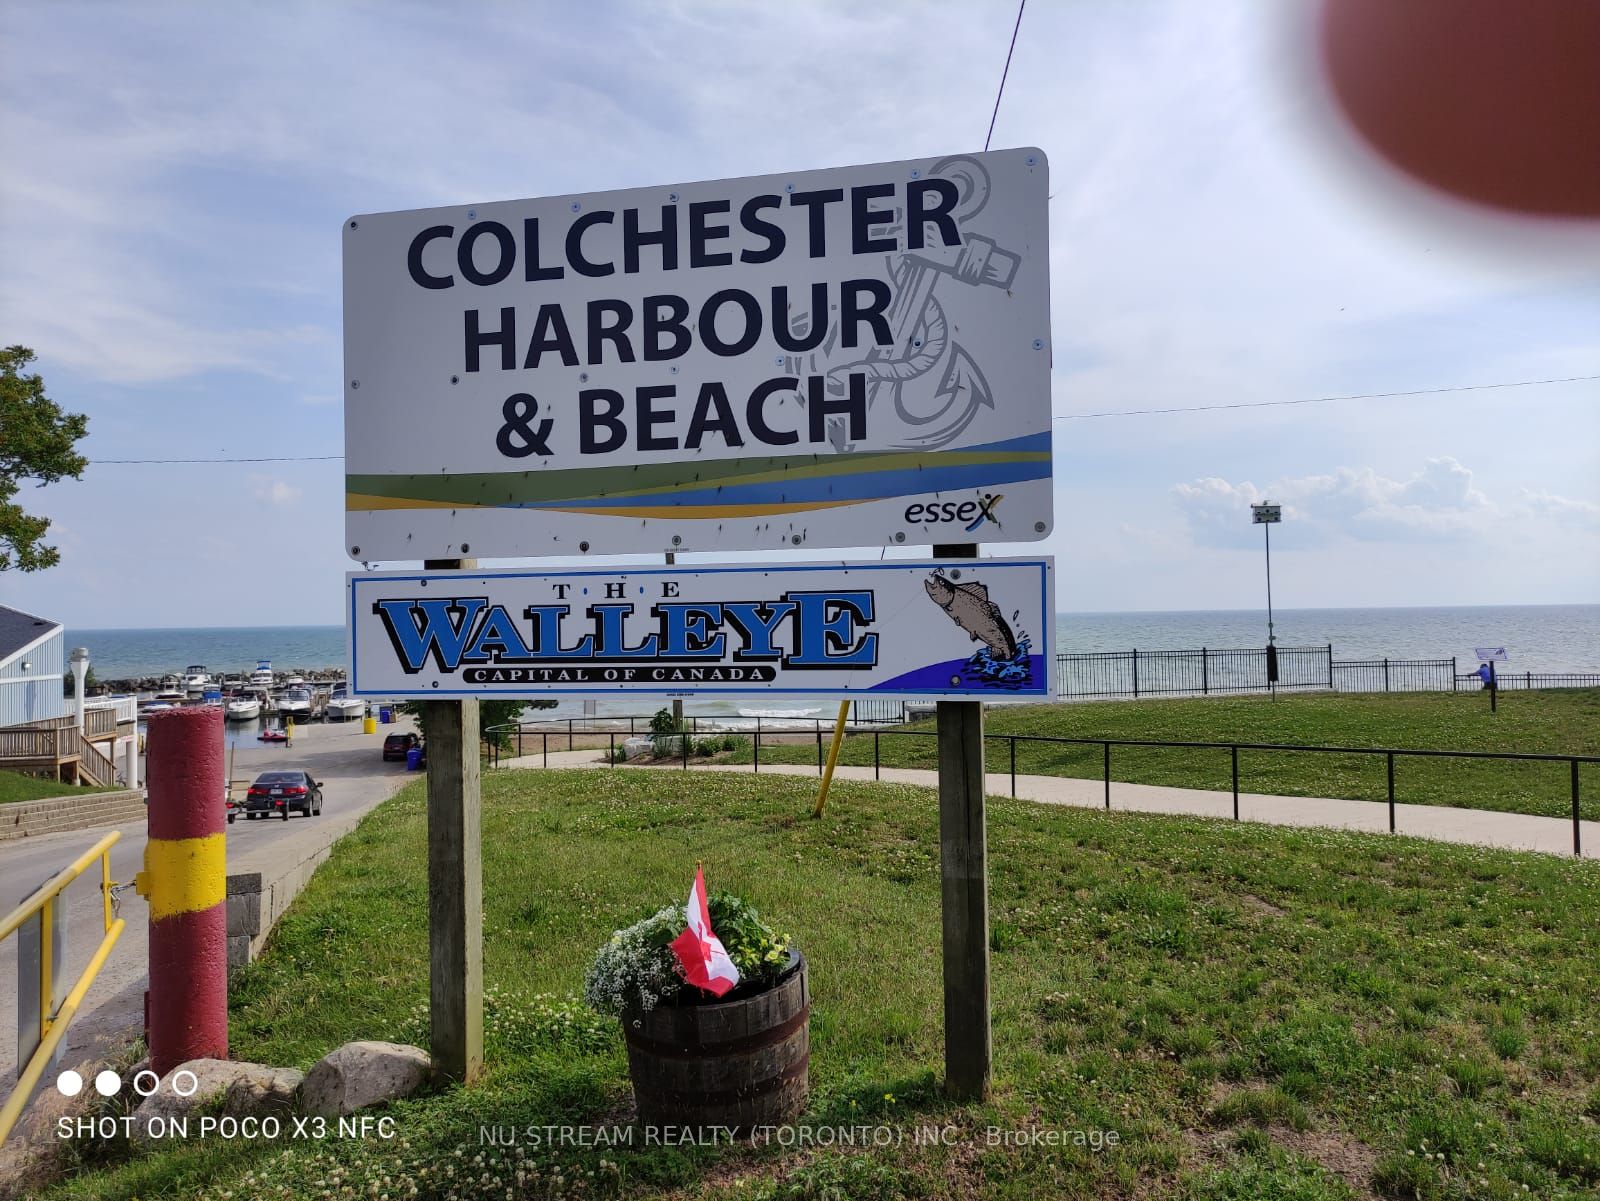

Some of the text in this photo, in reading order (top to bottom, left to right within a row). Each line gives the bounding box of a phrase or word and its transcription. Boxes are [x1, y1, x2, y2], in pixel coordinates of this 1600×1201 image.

[407, 177, 962, 290] COLCHESTER
[463, 277, 894, 373] HARBOUR
[495, 372, 868, 459] & BEACH
[904, 494, 1003, 532] essex
[474, 667, 764, 682] CAPITAL OF CANADA
